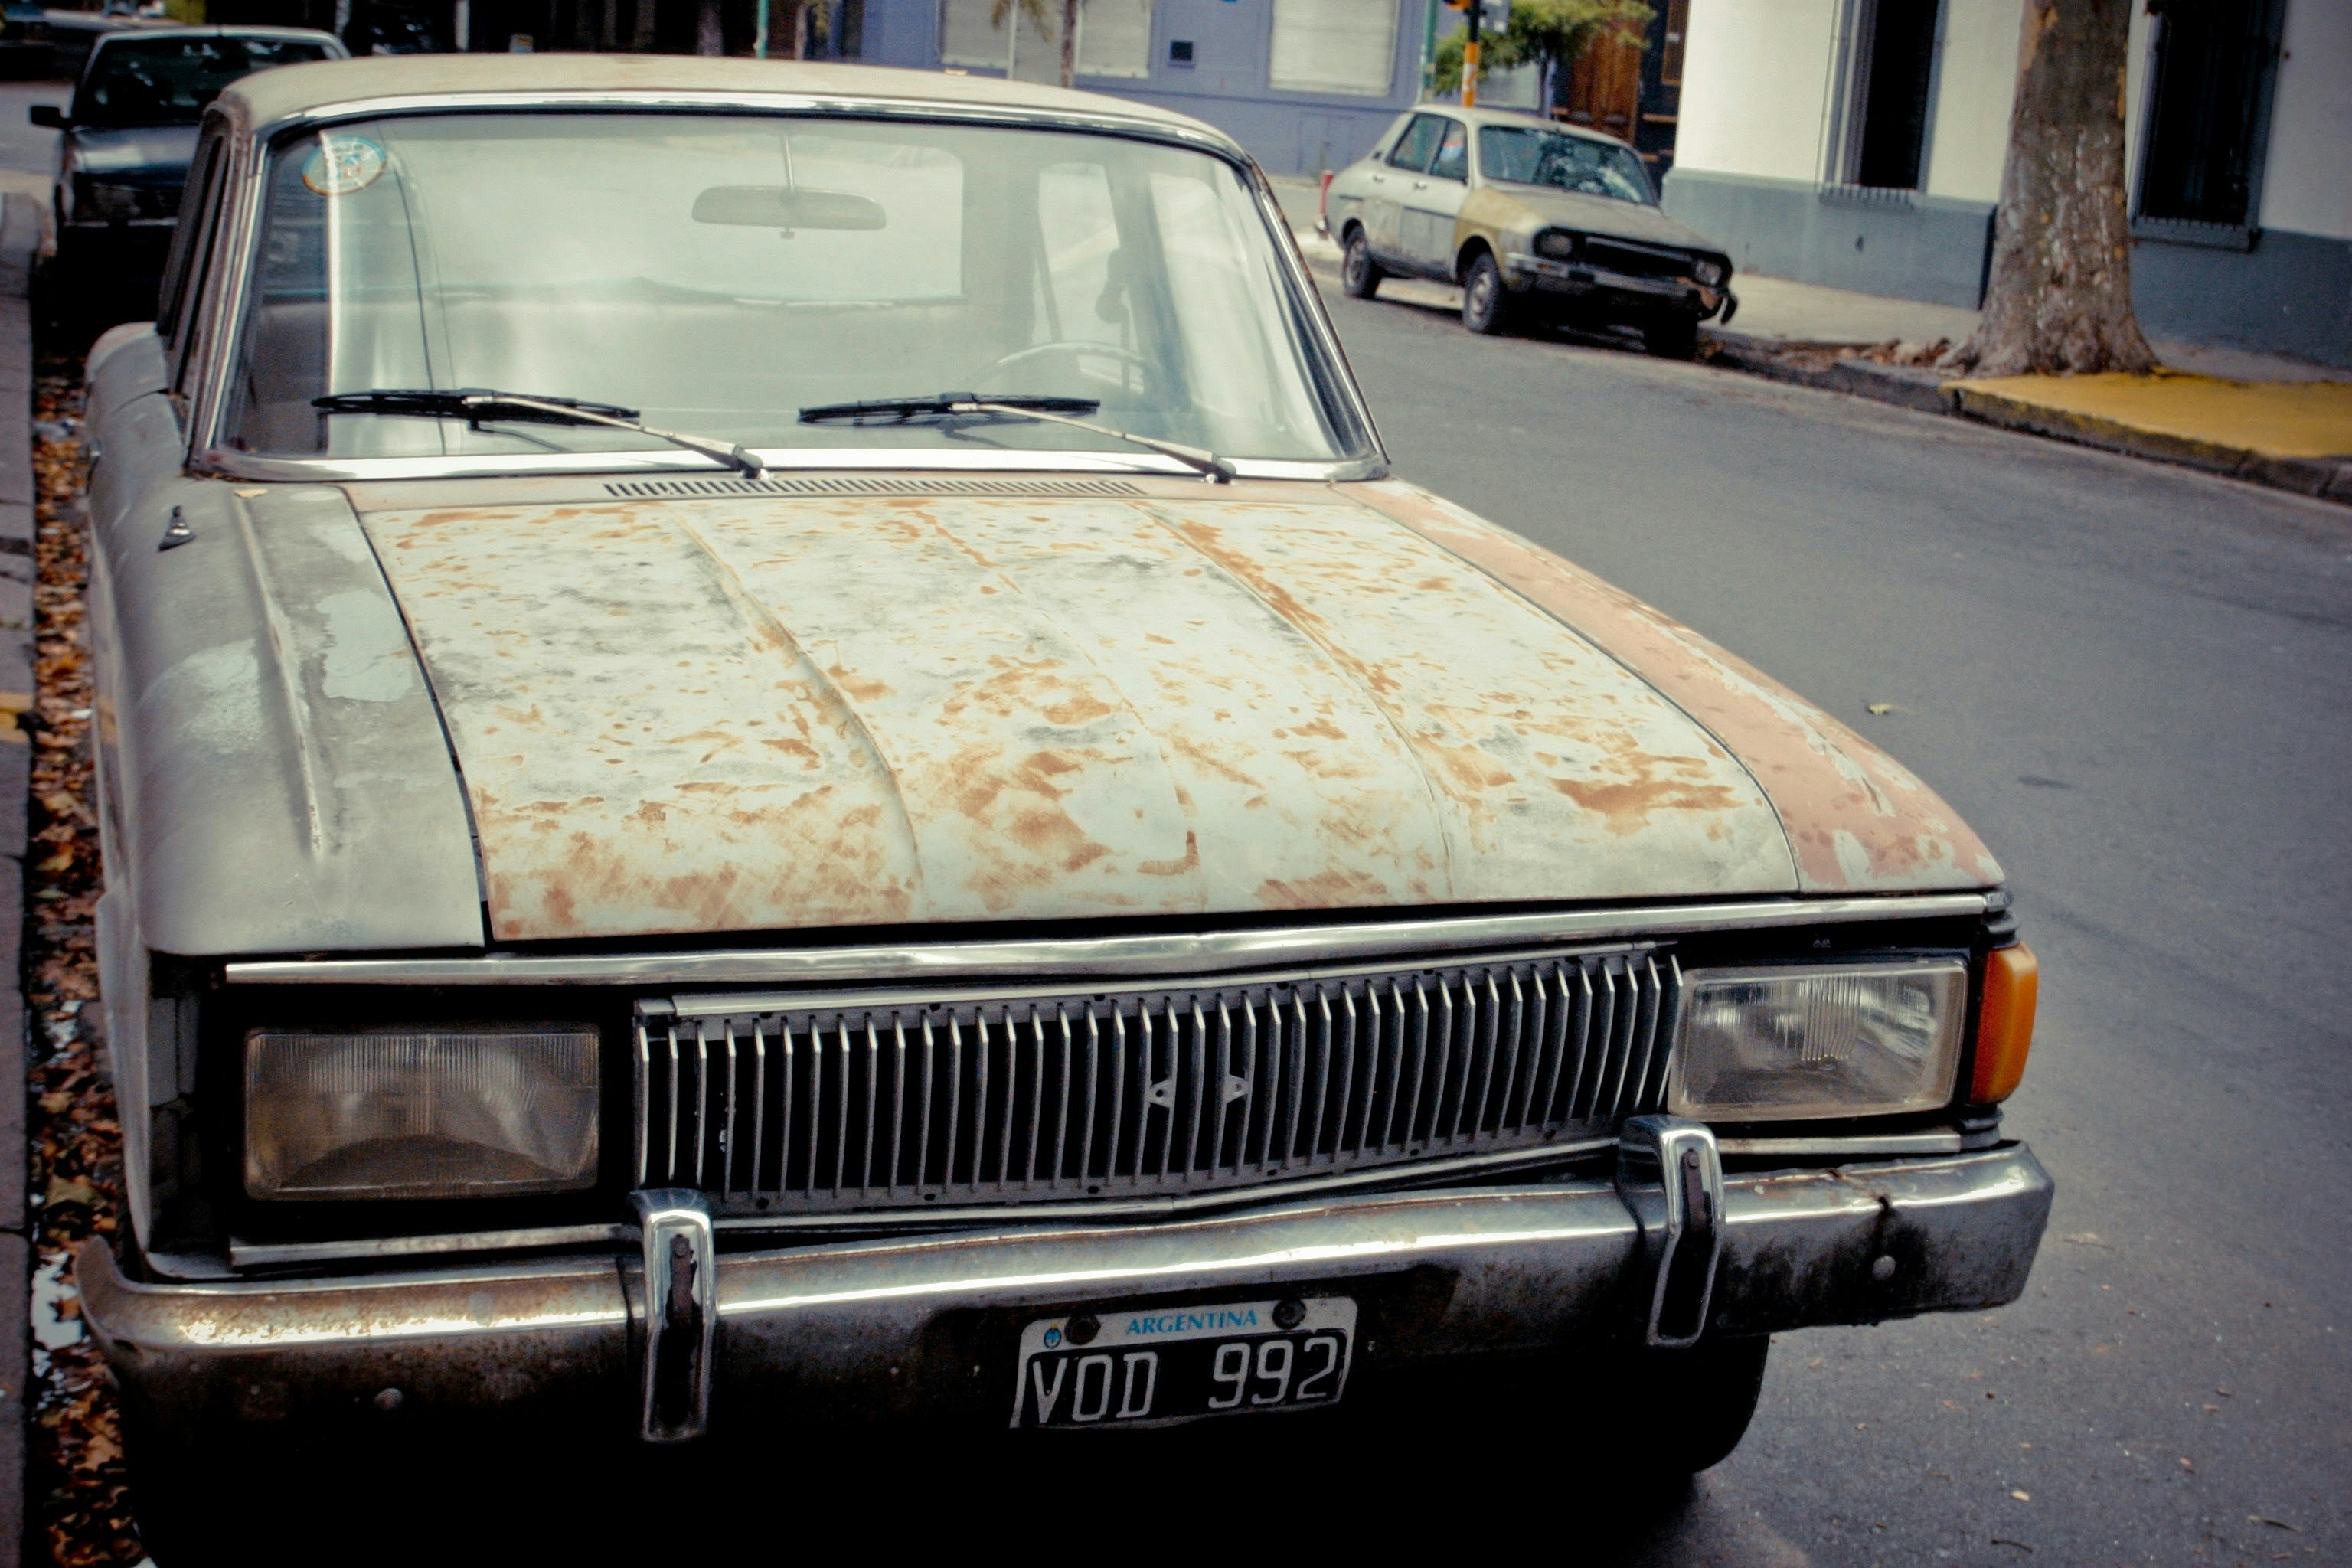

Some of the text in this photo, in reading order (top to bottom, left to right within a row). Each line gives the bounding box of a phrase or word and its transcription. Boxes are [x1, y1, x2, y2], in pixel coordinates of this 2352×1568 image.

[1126, 1309, 1258, 1335] ARGENTINA
[1032, 1336, 1338, 1424] VOD 992
